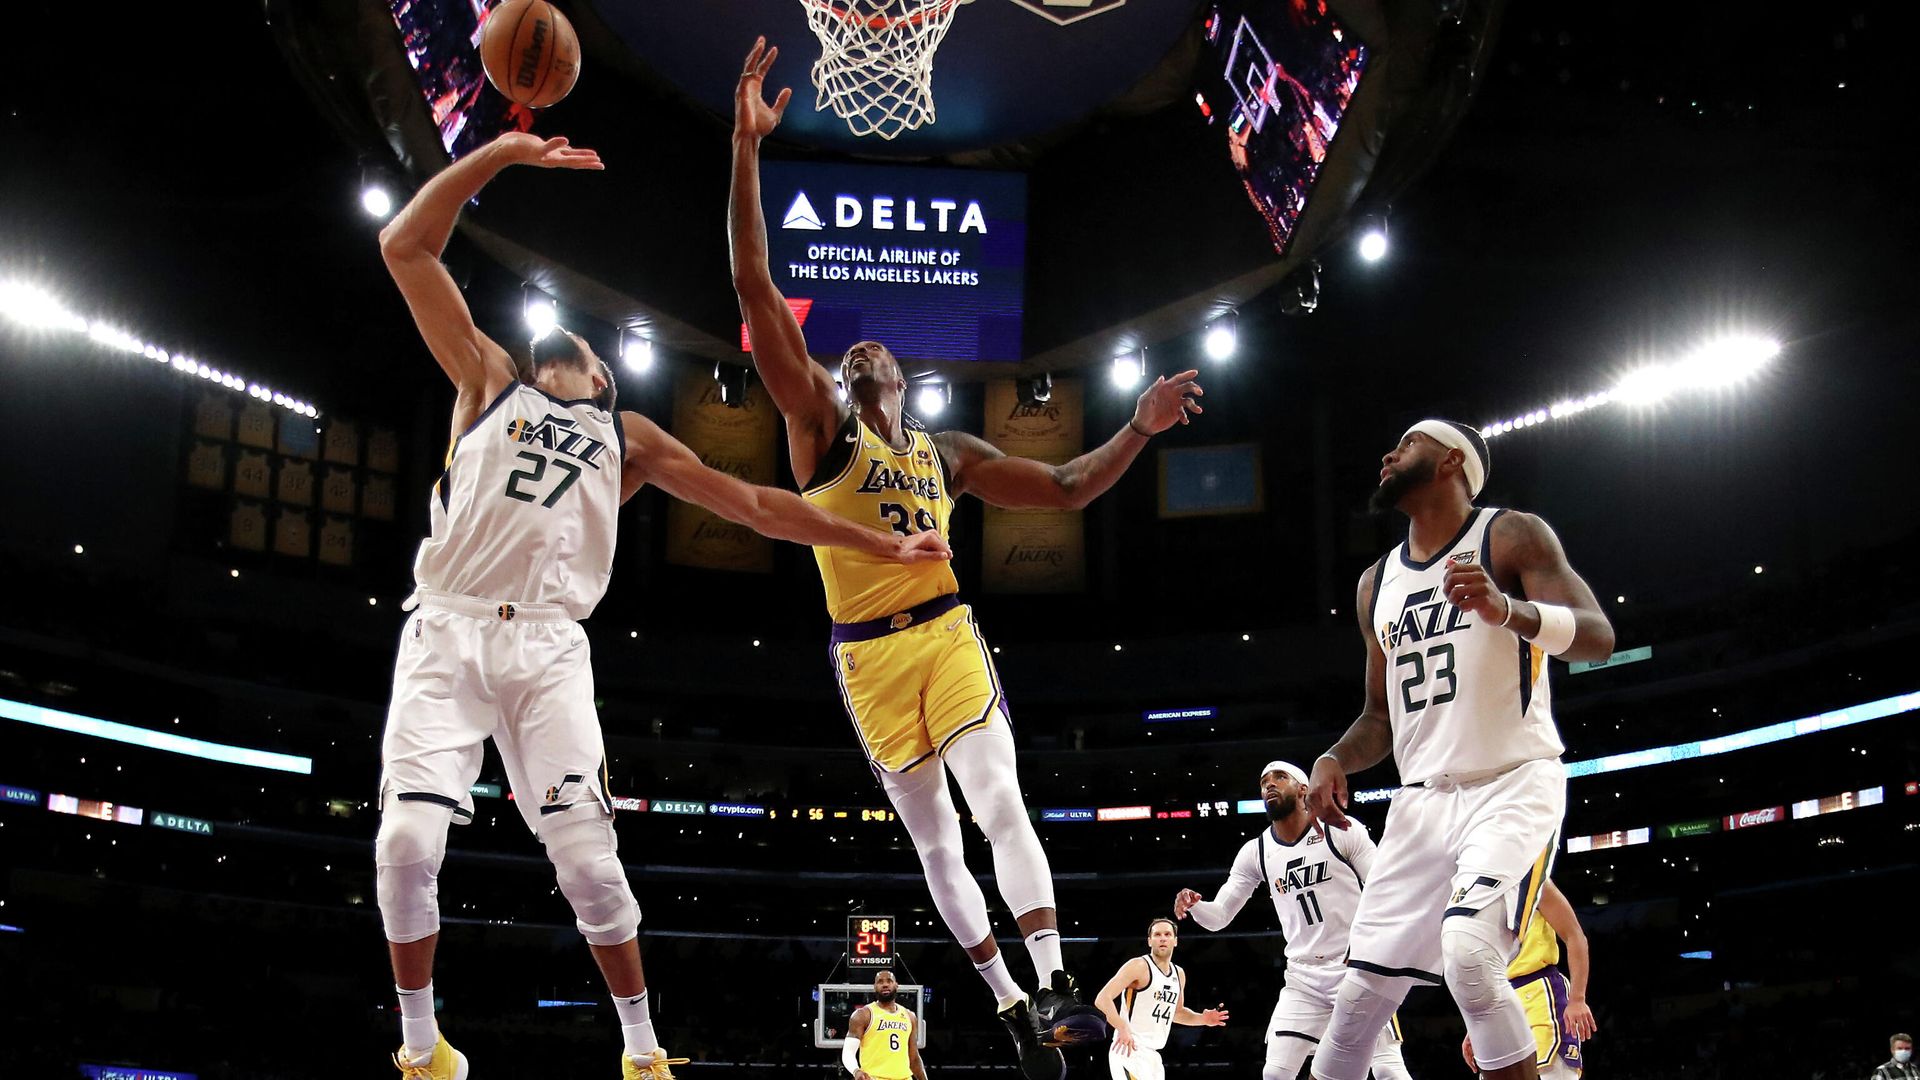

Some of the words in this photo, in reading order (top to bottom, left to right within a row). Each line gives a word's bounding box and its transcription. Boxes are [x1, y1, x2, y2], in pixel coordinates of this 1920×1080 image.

[516, 18, 548, 89] Wilson
[835, 196, 988, 234] DELTA
[807, 246, 875, 263] OFFICIAL
[879, 250, 937, 266] AIRLINE
[940, 252, 961, 266] OF
[789, 264, 819, 279] THE
[822, 266, 850, 281] LOS
[854, 268, 921, 284] ANGELES
[924, 271, 979, 286] LAKERS
[507, 413, 607, 469] JAZZ
[505, 450, 582, 509] 27
[856, 458, 940, 500] LAKERS
[1005, 544, 1065, 567] LAKERS
[1395, 642, 1458, 714] 23
[1147, 712, 1181, 720] AMERICAN
[1181, 709, 1212, 718] EXPRESS
[6, 789, 37, 802] ULTRA
[1353, 788, 1395, 804] Spectru
[665, 802, 705, 813] DELTA
[718, 804, 764, 814] crypto.com
[167, 816, 211, 834] DELTA
[1275, 856, 1333, 895] JAZZ
[1296, 890, 1324, 926] 11
[861, 919, 889, 933] 8:48
[856, 932, 887, 955] 24
[1154, 985, 1178, 1004] JAZZ
[877, 1019, 908, 1032] LAKERS
[1151, 1003, 1171, 1026] 44
[889, 1033, 900, 1051] 6
